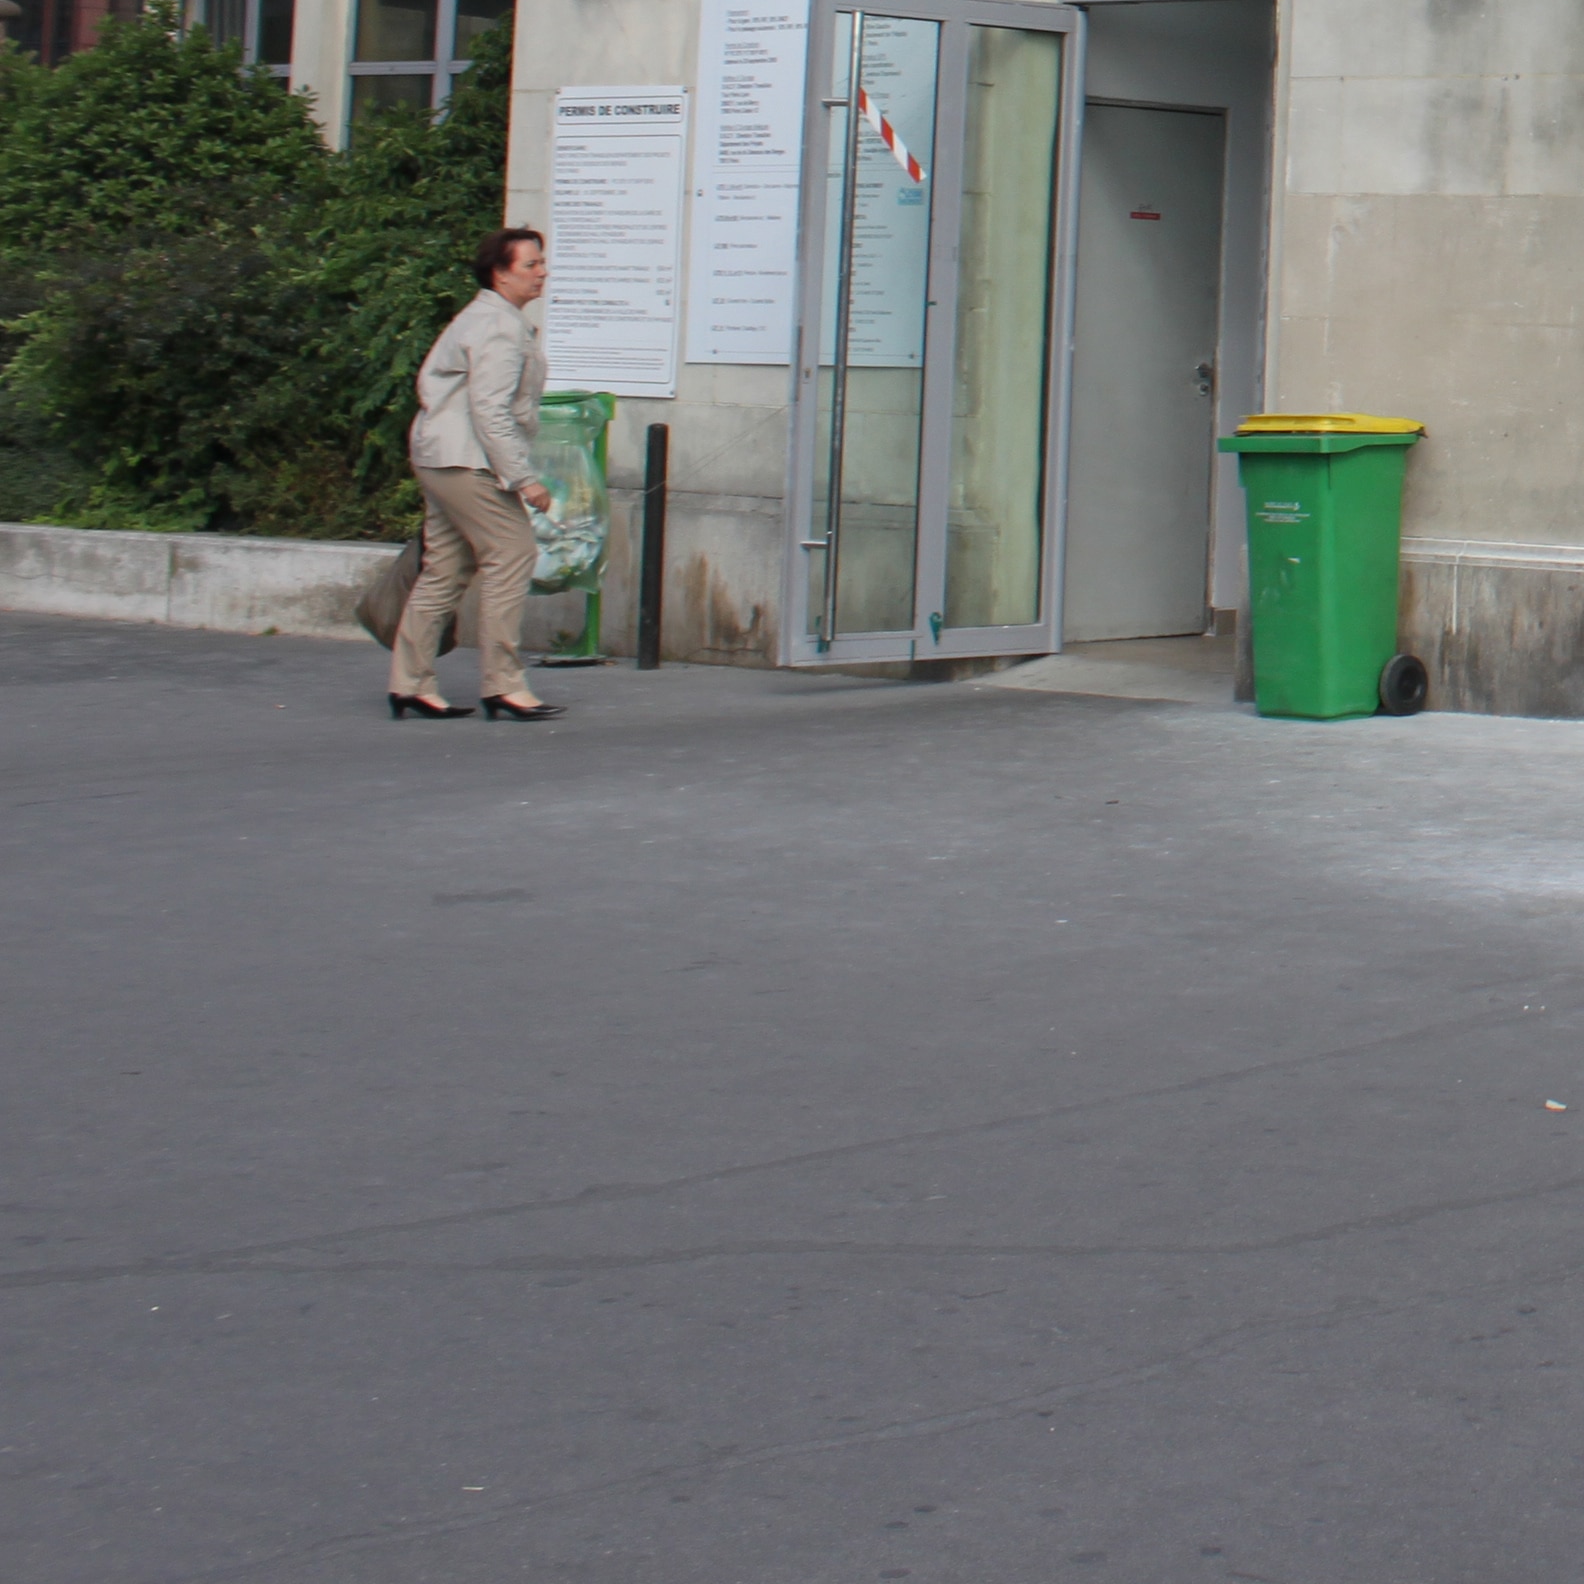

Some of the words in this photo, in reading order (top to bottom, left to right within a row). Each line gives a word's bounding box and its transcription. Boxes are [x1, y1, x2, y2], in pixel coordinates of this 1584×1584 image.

[558, 105, 596, 116] PERMIS
[598, 105, 612, 116] DE
[614, 103, 681, 116] CONSTRUIRE
